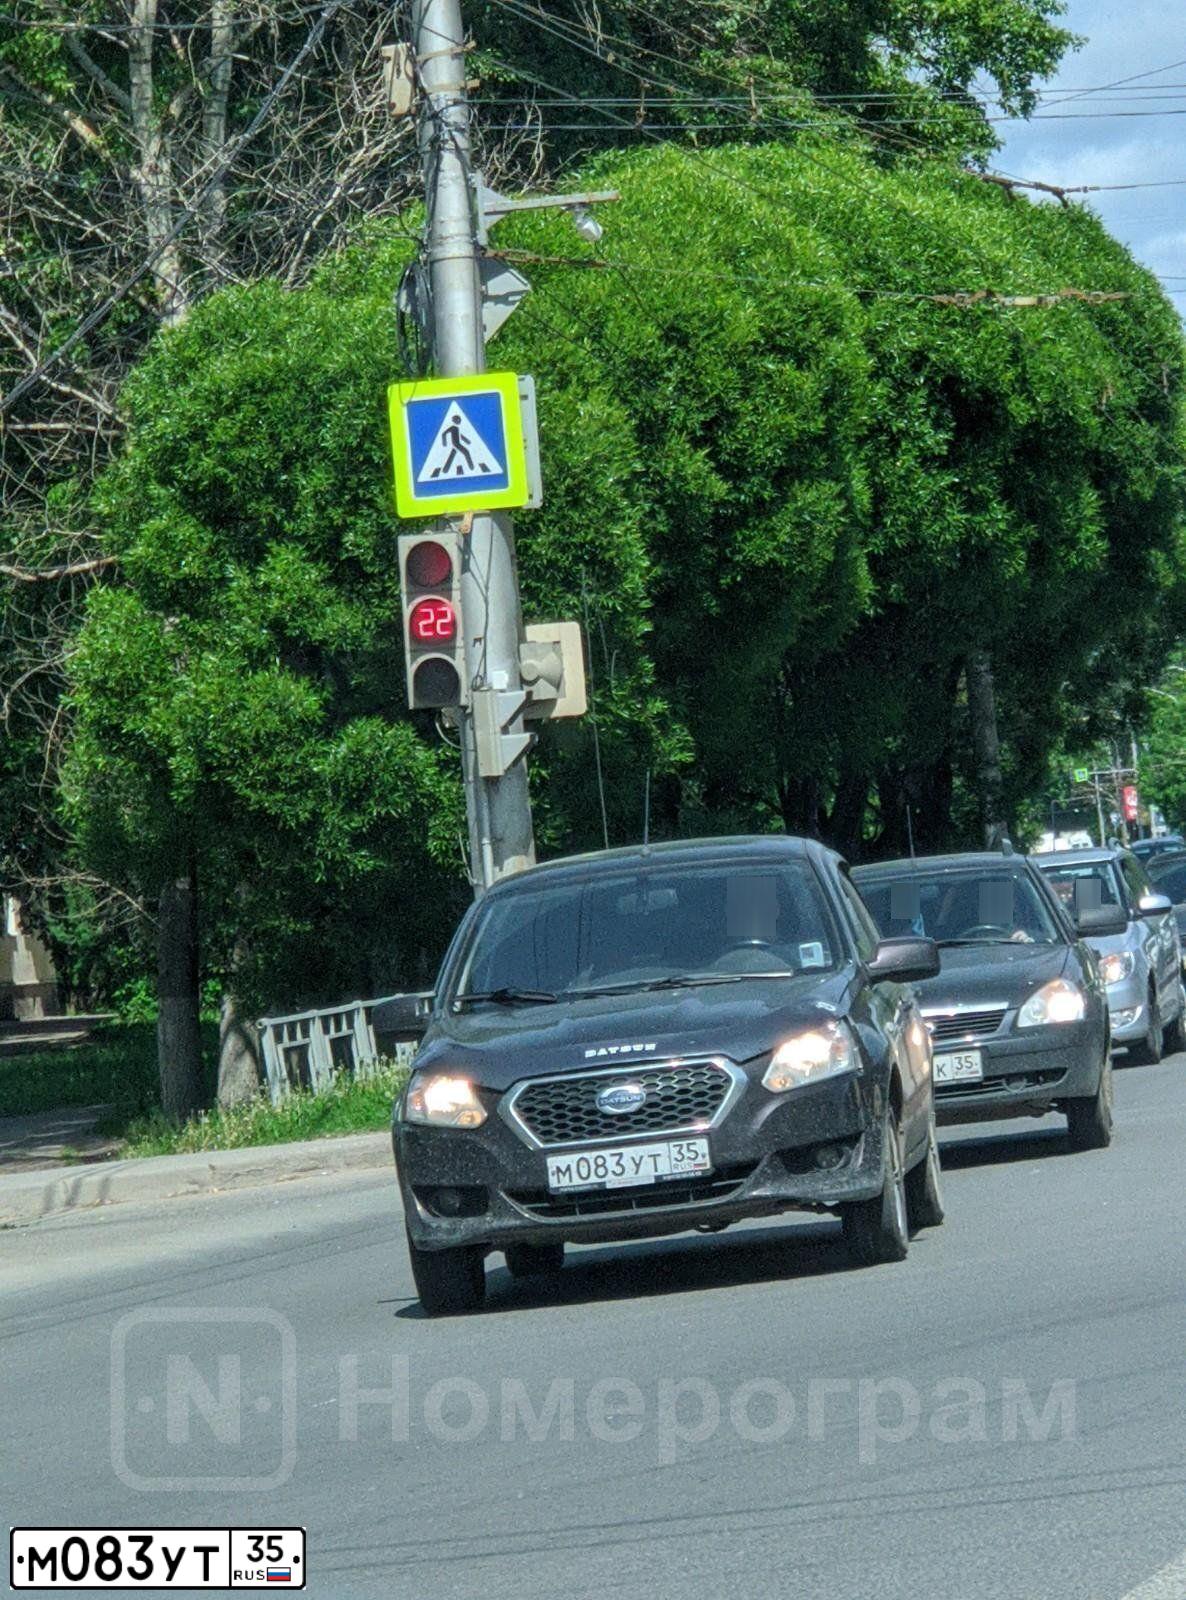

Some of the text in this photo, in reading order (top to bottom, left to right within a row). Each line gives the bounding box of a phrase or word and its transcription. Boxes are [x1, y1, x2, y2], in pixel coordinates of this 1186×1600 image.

[418, 606, 452, 637] 22
[953, 1055, 974, 1071] 35
[555, 1141, 700, 1184] М083УТ 35
